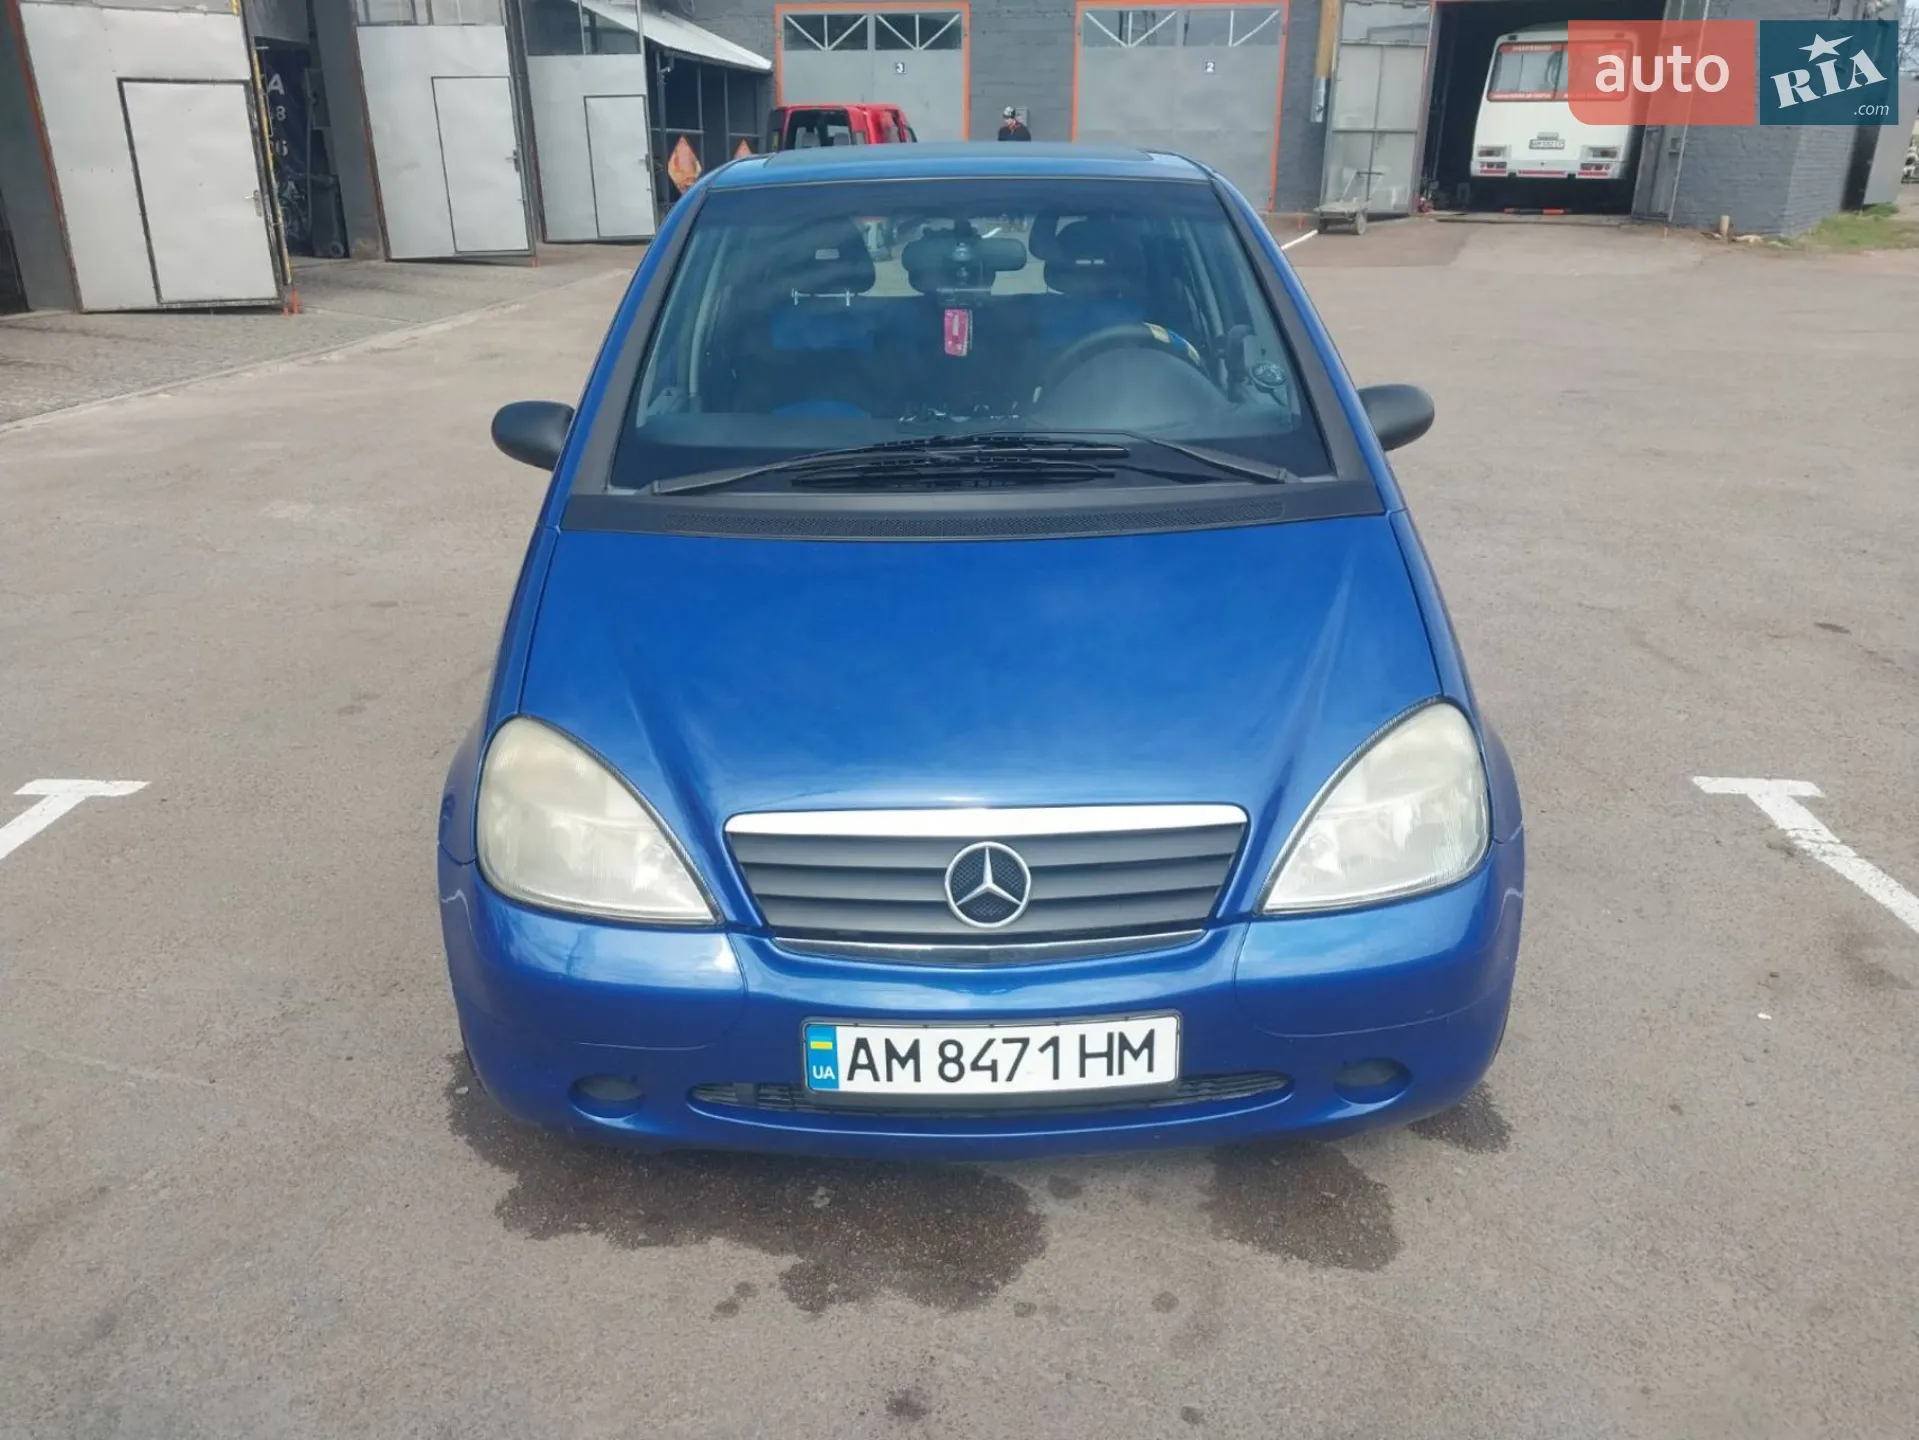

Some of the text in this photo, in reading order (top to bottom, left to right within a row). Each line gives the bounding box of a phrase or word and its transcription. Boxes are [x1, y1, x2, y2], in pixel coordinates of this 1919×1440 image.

[812, 1064, 836, 1080] UA
[846, 1028, 1156, 1084] AM 8471 HM
